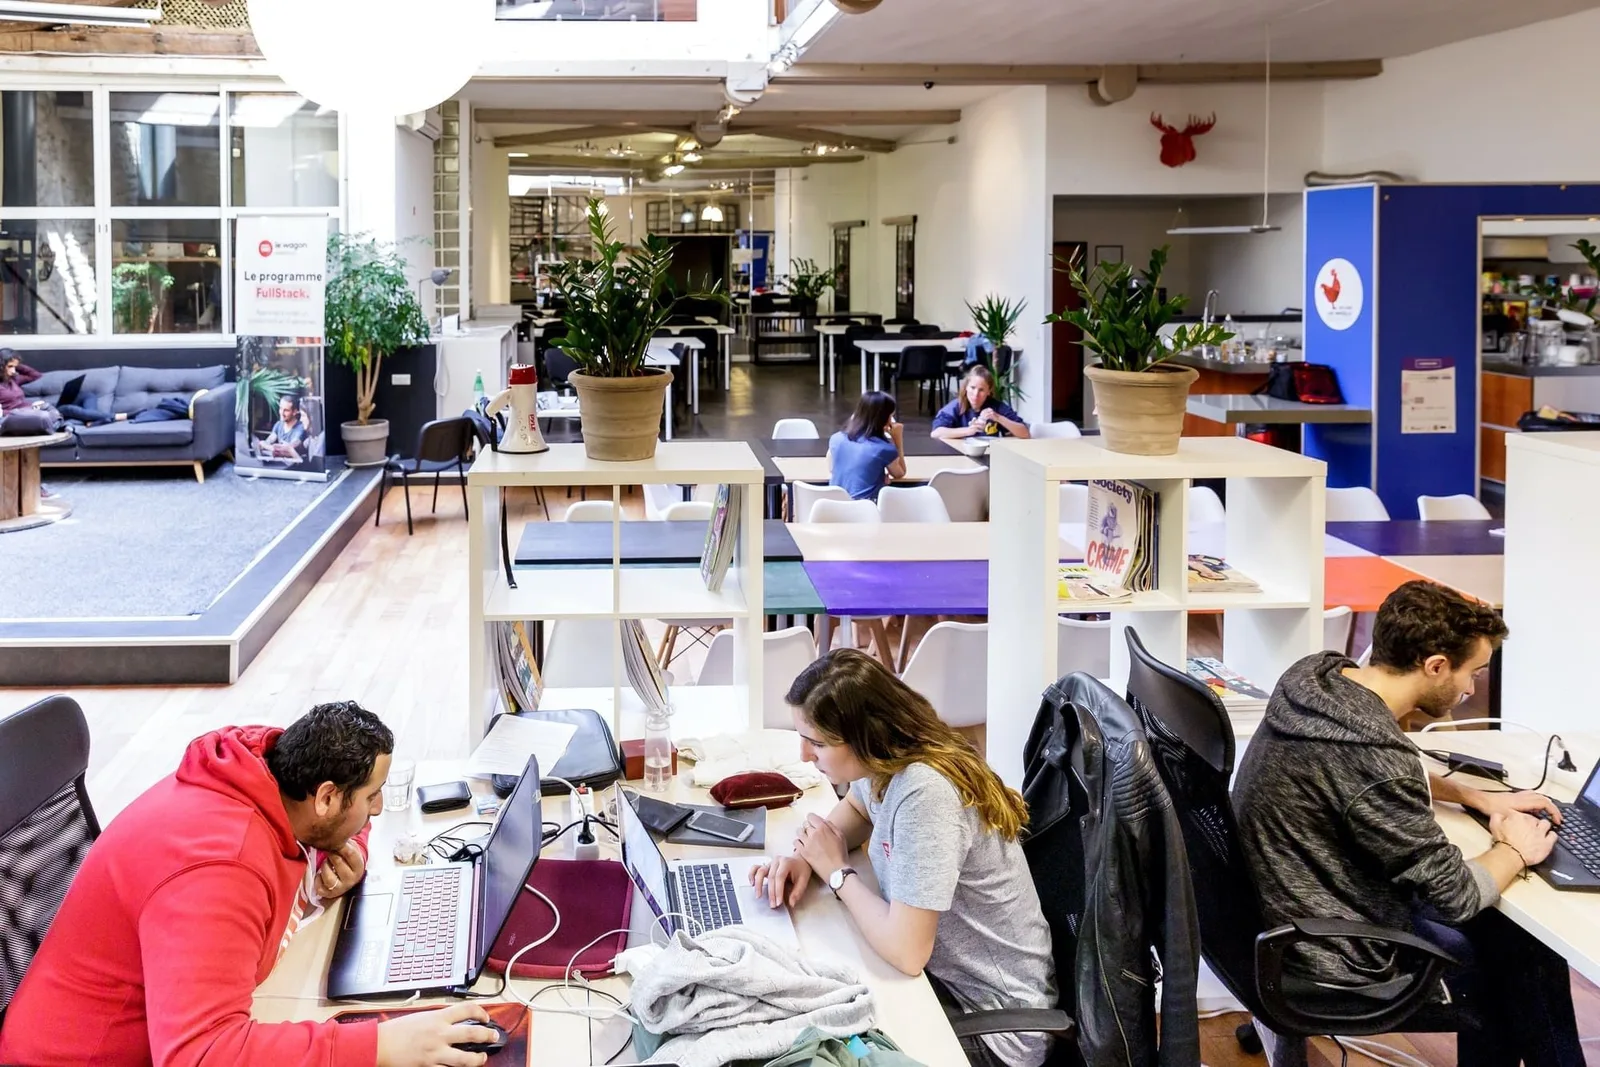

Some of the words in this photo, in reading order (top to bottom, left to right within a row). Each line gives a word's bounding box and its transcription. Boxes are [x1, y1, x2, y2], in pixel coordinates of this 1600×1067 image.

[283, 242, 308, 250] wagon
[244, 271, 257, 281] Le
[259, 273, 322, 284] programme
[256, 287, 310, 299] FullStack.
[1087, 540, 1129, 574] CRIME
